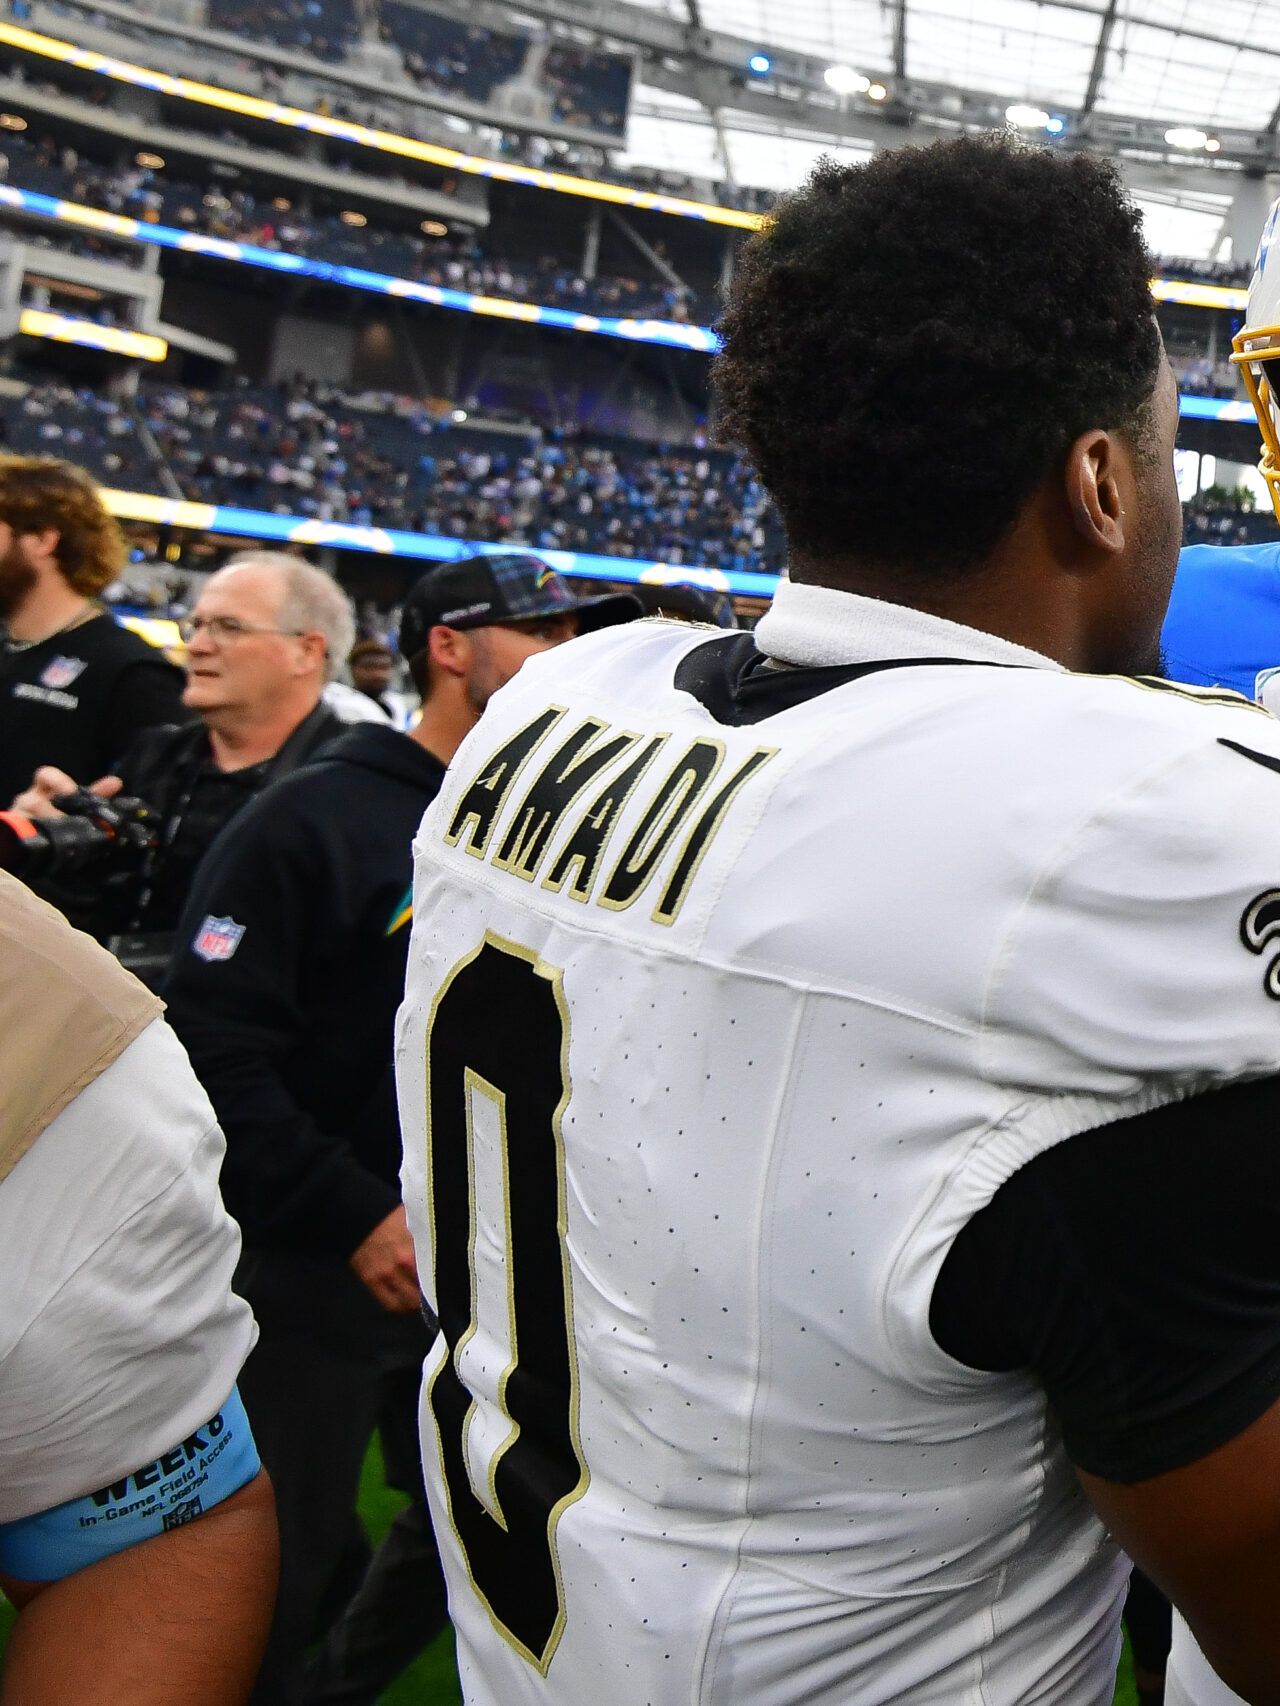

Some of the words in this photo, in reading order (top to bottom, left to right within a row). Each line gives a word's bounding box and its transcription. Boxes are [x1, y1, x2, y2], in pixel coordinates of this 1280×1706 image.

[443, 703, 781, 927] AMADI
[427, 929, 590, 1678] 0
[79, 1494, 155, 1527] In-Game
[159, 1467, 196, 1497] Field
[200, 1430, 233, 1471] Access
[91, 1430, 209, 1507] WEEK
[142, 1504, 165, 1518] NFL
